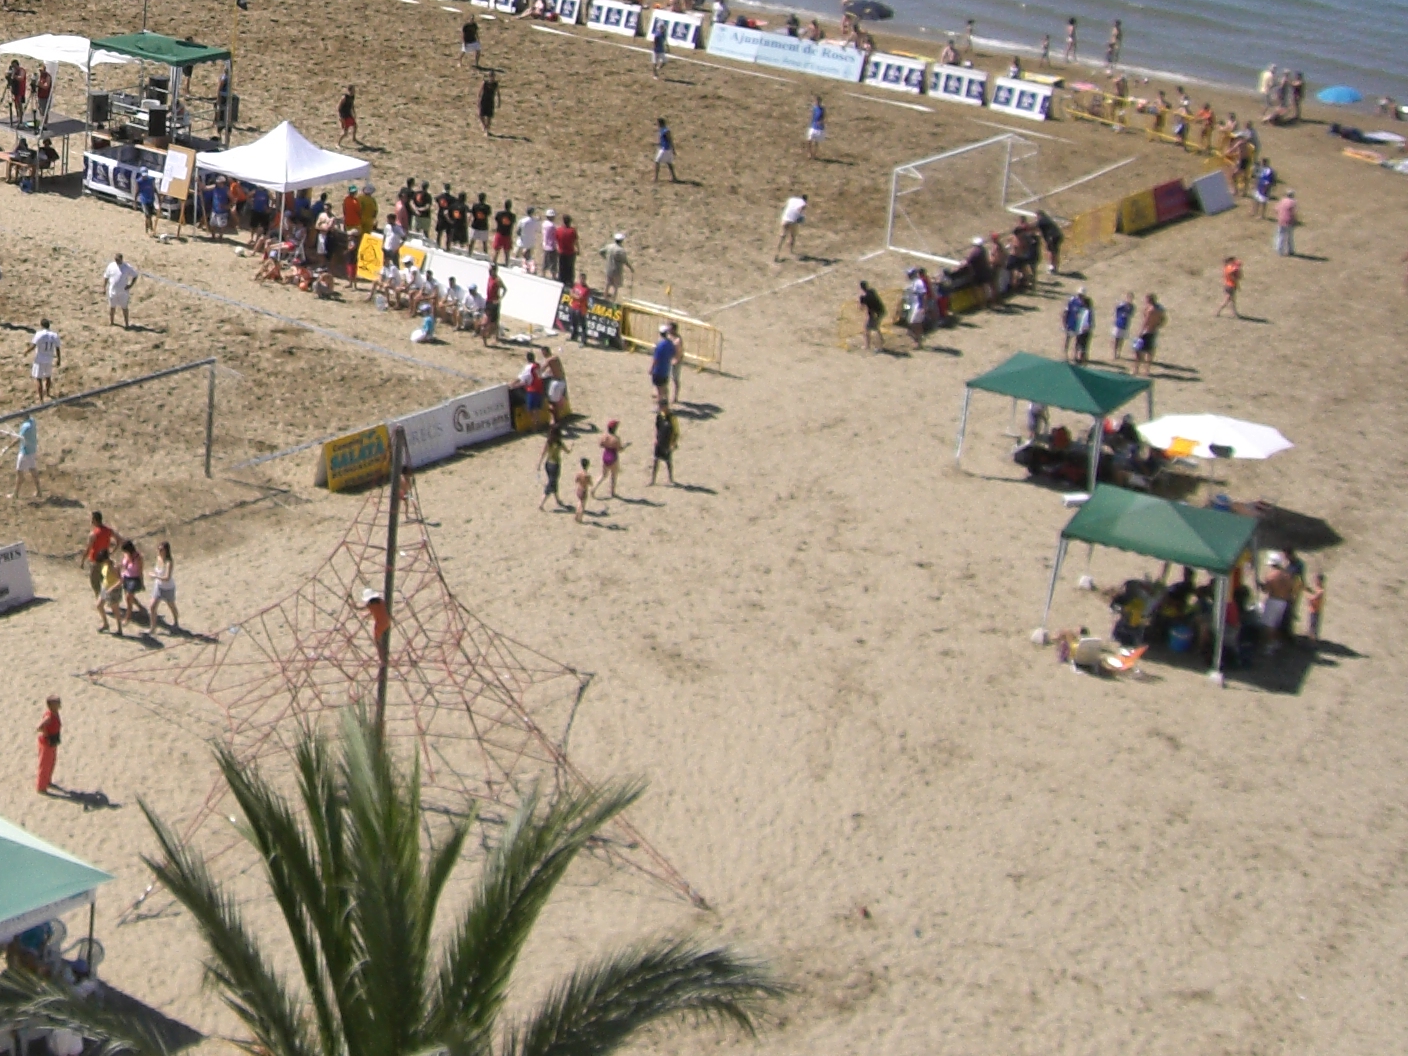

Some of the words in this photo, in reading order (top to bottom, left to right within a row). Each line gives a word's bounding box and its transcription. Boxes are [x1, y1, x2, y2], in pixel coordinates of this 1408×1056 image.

[732, 31, 800, 53] Ajuntament
[803, 45, 817, 56] de
[822, 47, 856, 63] Roses
